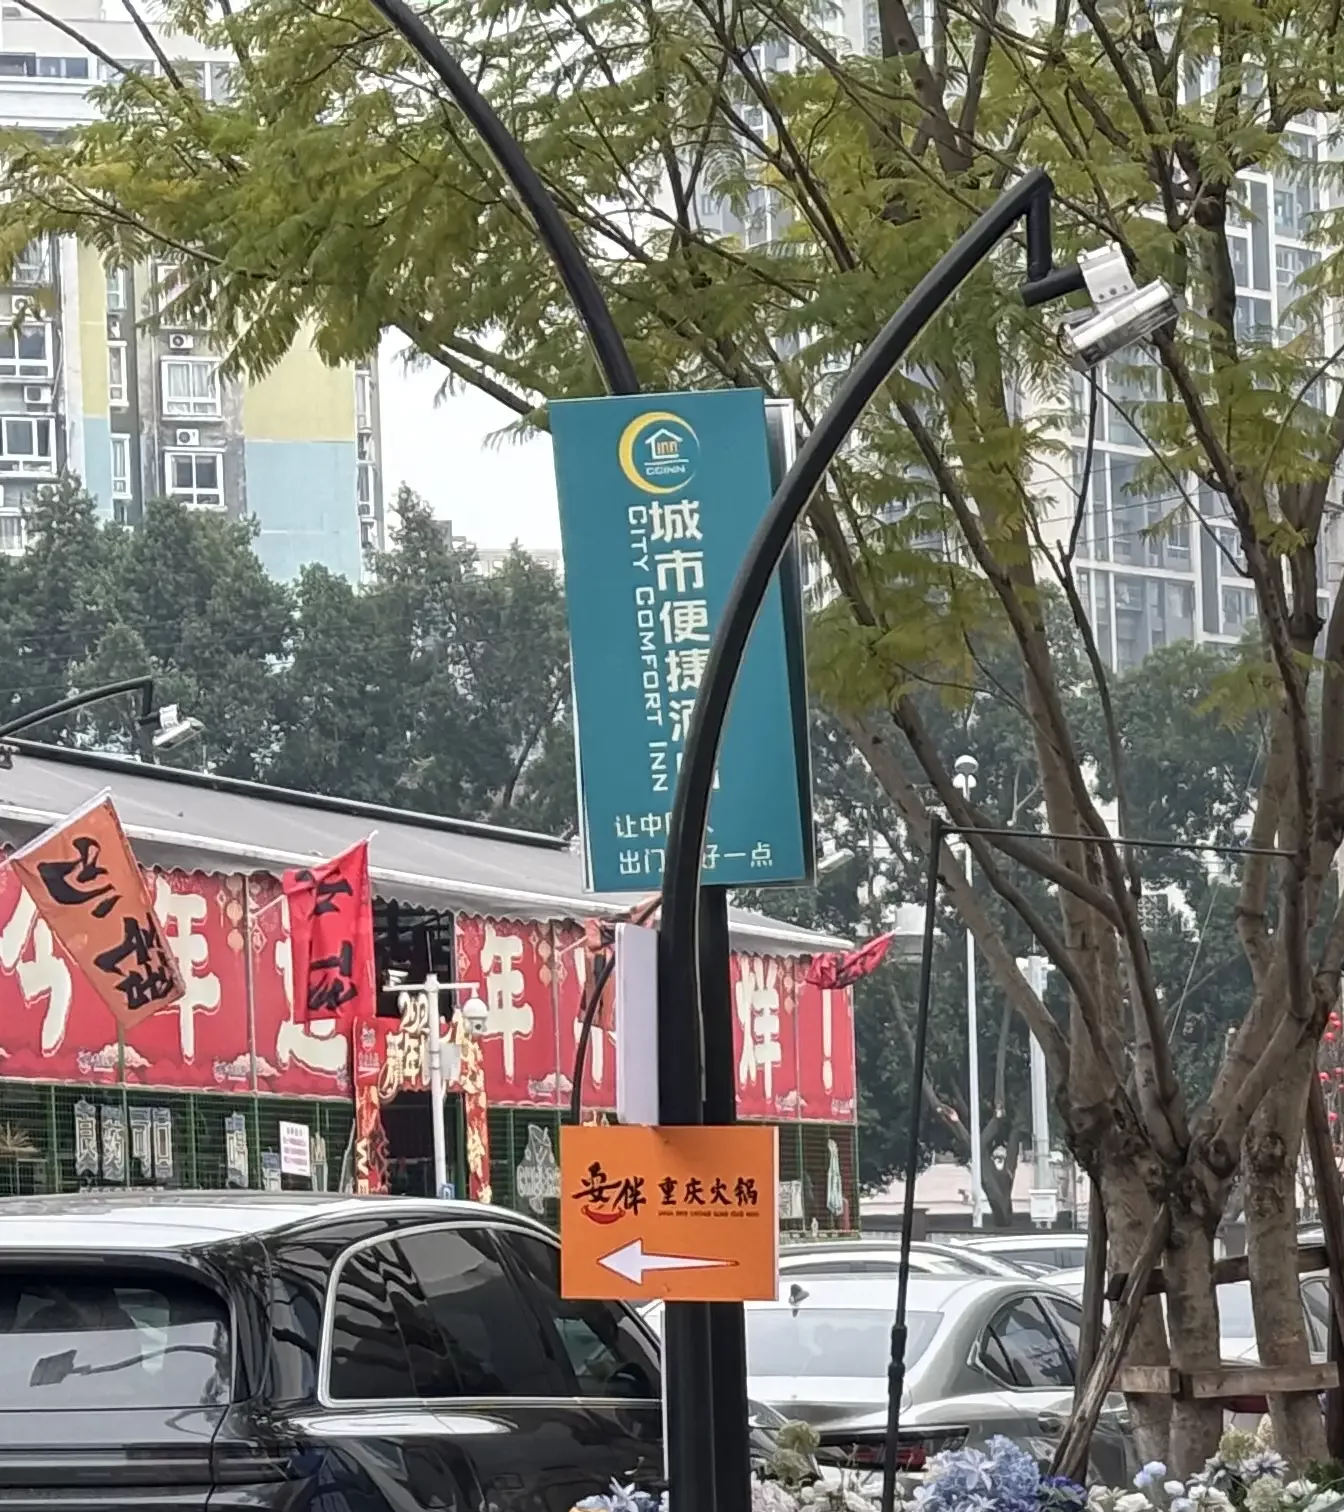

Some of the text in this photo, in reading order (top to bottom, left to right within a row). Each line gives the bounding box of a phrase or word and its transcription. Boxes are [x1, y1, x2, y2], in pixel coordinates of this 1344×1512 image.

[628, 505, 669, 792] CITY COMFORT INN
[649, 499, 720, 789] 城市便捷
[614, 811, 714, 840] 让中
[619, 842, 773, 876] 出门好一点
[658, 1175, 759, 1207] 重庆火锅
